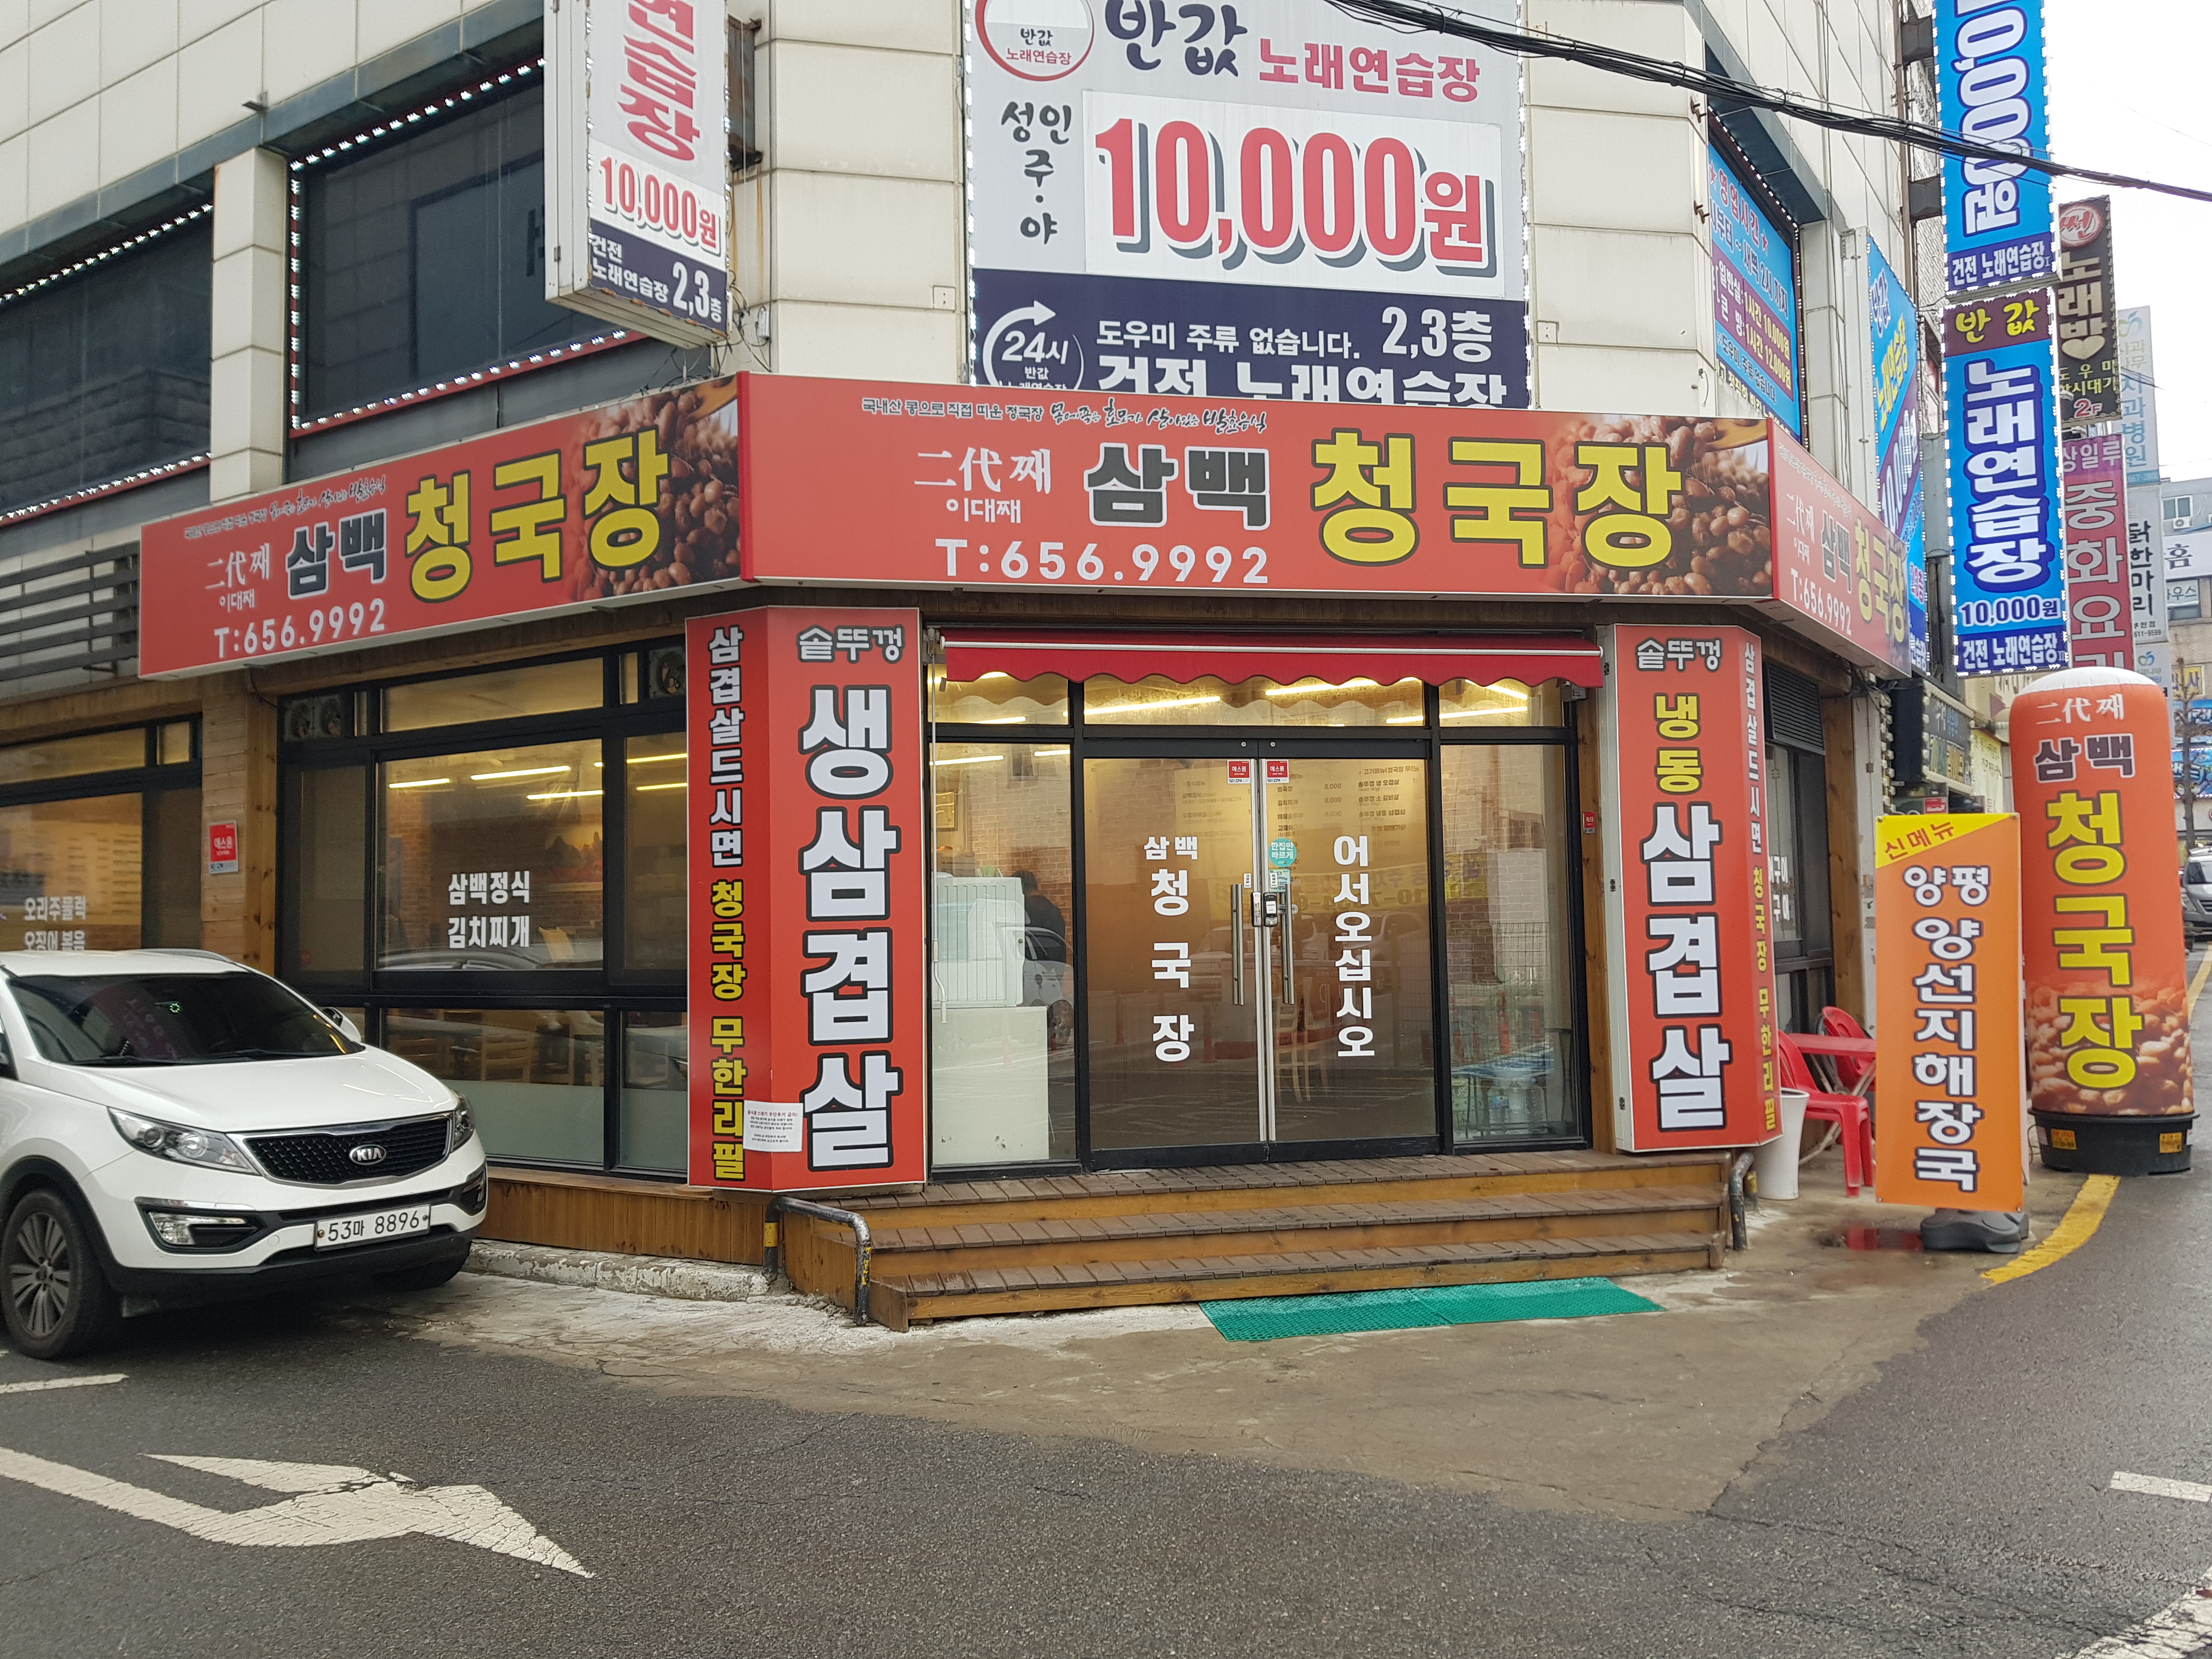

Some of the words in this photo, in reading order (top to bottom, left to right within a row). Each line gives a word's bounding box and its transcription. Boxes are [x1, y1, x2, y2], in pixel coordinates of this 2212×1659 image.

[1006, 47, 1071, 65] 노래연습장
[1020, 27, 1053, 47] 반값
[1105, 0, 1248, 77] 반값
[1259, 37, 1480, 103] 노래연습장
[1001, 101, 1072, 144] 성인
[600, 156, 719, 252] 10,000원
[1094, 118, 1489, 272] 10,000원
[1719, 168, 1759, 246] 영업시간
[592, 235, 622, 264] 건전
[1951, 254, 1977, 286] 건전
[1981, 240, 2046, 279] 노래연습장
[592, 258, 668, 303] 노래연습장
[672, 261, 723, 324] 2,3층
[1097, 320, 1175, 350] 도우미
[1187, 323, 1240, 354] 주류
[1249, 328, 1360, 359] 없습니다.
[1382, 306, 1493, 363] 2,3층
[1745, 291, 1762, 328] 1시간
[1764, 313, 1790, 360] 10,000원
[1956, 298, 2041, 343] 반값
[1001, 330, 1069, 365] 24시
[1746, 323, 1763, 359] 1시간
[1765, 345, 1792, 391] 12,000원
[1025, 366, 1049, 380] 반값
[1876, 314, 1909, 431] 노래연습장
[862, 398, 902, 415] 국내산
[906, 400, 945, 416] 콩으로
[947, 402, 973, 418] 직접
[1102, 396, 1143, 427] 효모가
[1201, 407, 1267, 433] 발효음식
[2074, 398, 2103, 419] 2F
[1966, 359, 2047, 585] 노래연습장
[285, 507, 387, 600] 삼백
[405, 426, 670, 603] 청국장
[946, 498, 1021, 523] 이대째
[1084, 442, 1270, 530] 삼백
[1312, 427, 1683, 569] 청국장
[935, 538, 1268, 584] T:656.9992
[1821, 509, 1852, 594] 삼백
[1855, 517, 1905, 643] 청국장
[2129, 521, 2154, 616] 닭한마리
[2164, 543, 2193, 570] 홈
[220, 589, 255, 613] 이대째
[1791, 568, 1852, 636] T:656.9992
[1960, 595, 2062, 627] 10,000원
[214, 597, 385, 659] T:656.9992
[795, 625, 904, 664] 솥뚜껑
[1962, 638, 1989, 669] 건전
[1992, 631, 2060, 666] 노래연습장
[1636, 637, 1722, 673] 솥뚜껑
[1654, 692, 1704, 795] 냉동
[2035, 732, 2136, 784] 삼백
[1144, 834, 1199, 861] 삼백
[1883, 819, 1955, 861] 신메뉴
[25, 895, 86, 921] 오리주물럭
[448, 871, 531, 906] 삼백정식
[1903, 864, 1991, 907] 양평
[447, 916, 531, 950] 김치찌개
[709, 879, 746, 1002] 청국장
[798, 684, 904, 1171] 생삼겹살
[1753, 865, 1768, 973] 청국장
[2046, 790, 2145, 1091] 청국장
[1333, 834, 1374, 1058] 어서오십시오
[1640, 801, 1731, 1132] 삼겹살
[1759, 986, 1778, 1131] 무한리필
[1913, 916, 1983, 1193] 양선지해장국
[709, 1014, 746, 1182] 무한리필
[357, 1148, 382, 1161] KIA
[328, 1220, 364, 1242] 53마
[374, 1210, 419, 1234] 8896
